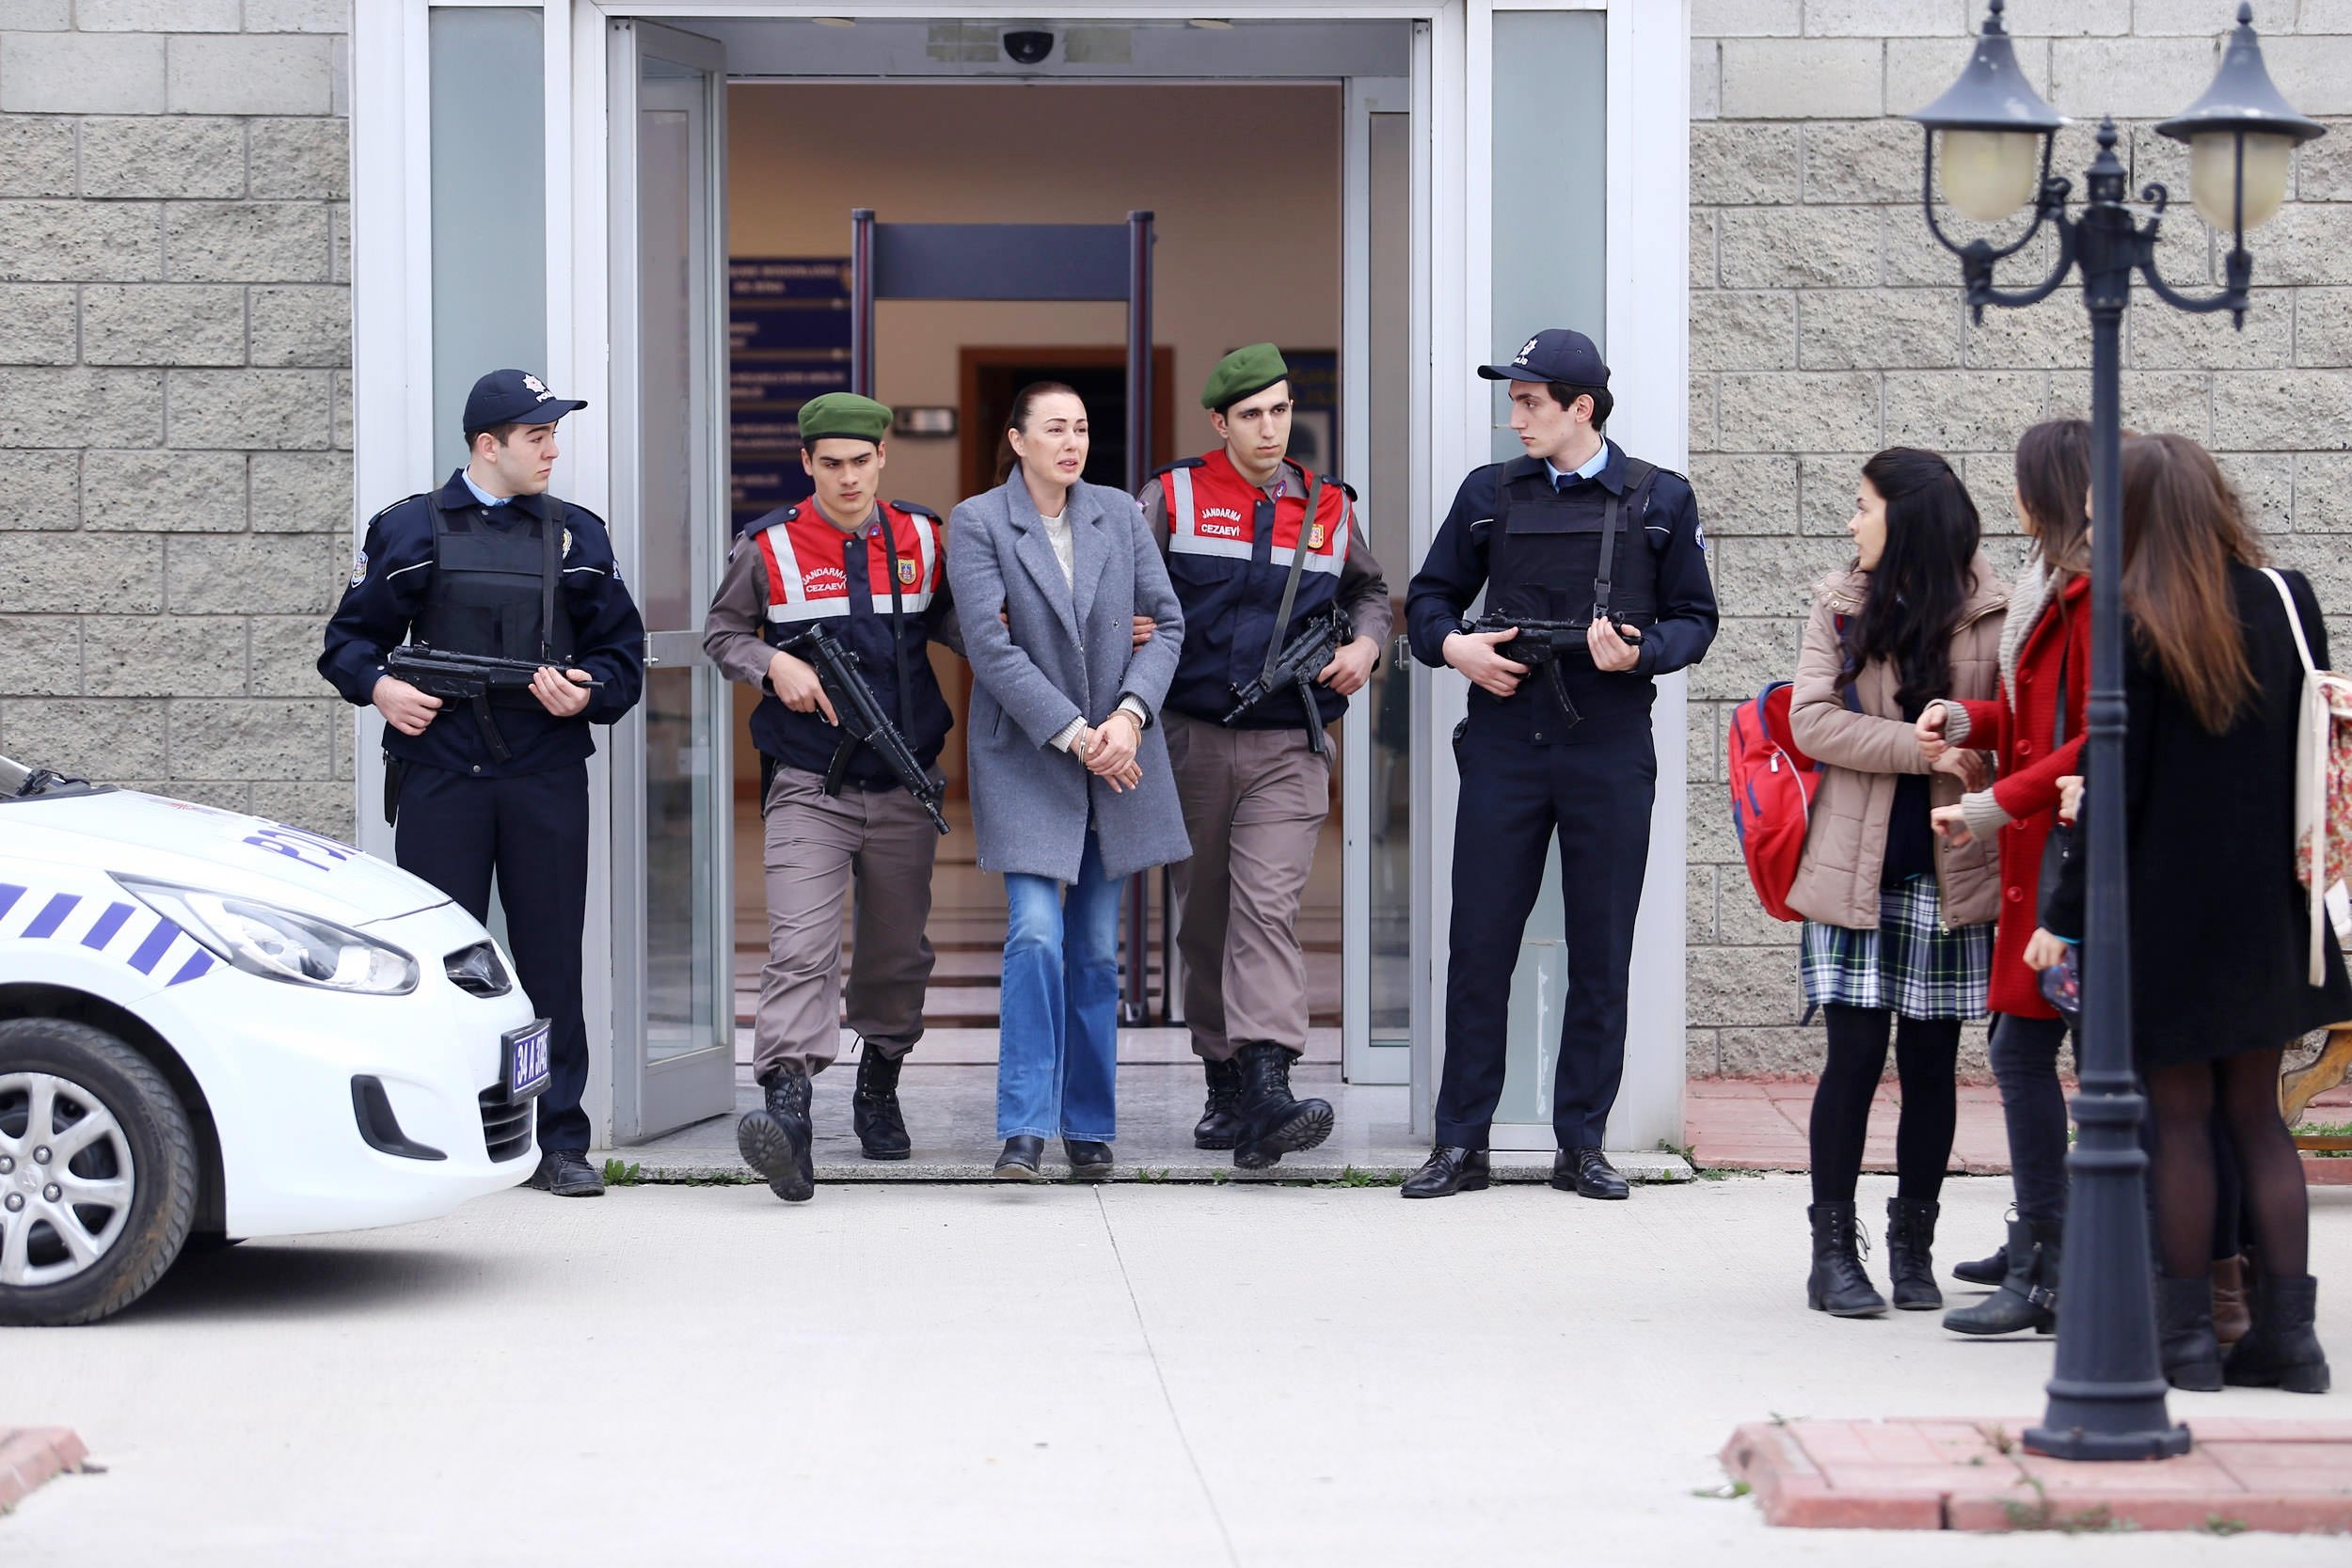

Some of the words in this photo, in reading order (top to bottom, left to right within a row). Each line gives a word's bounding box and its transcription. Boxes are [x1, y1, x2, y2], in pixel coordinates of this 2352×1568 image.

[1201, 507, 1242, 522] JANDARMA
[1200, 523, 1240, 536] CEZAEVİ
[516, 1041, 529, 1085] 34
[528, 1038, 535, 1080] A
